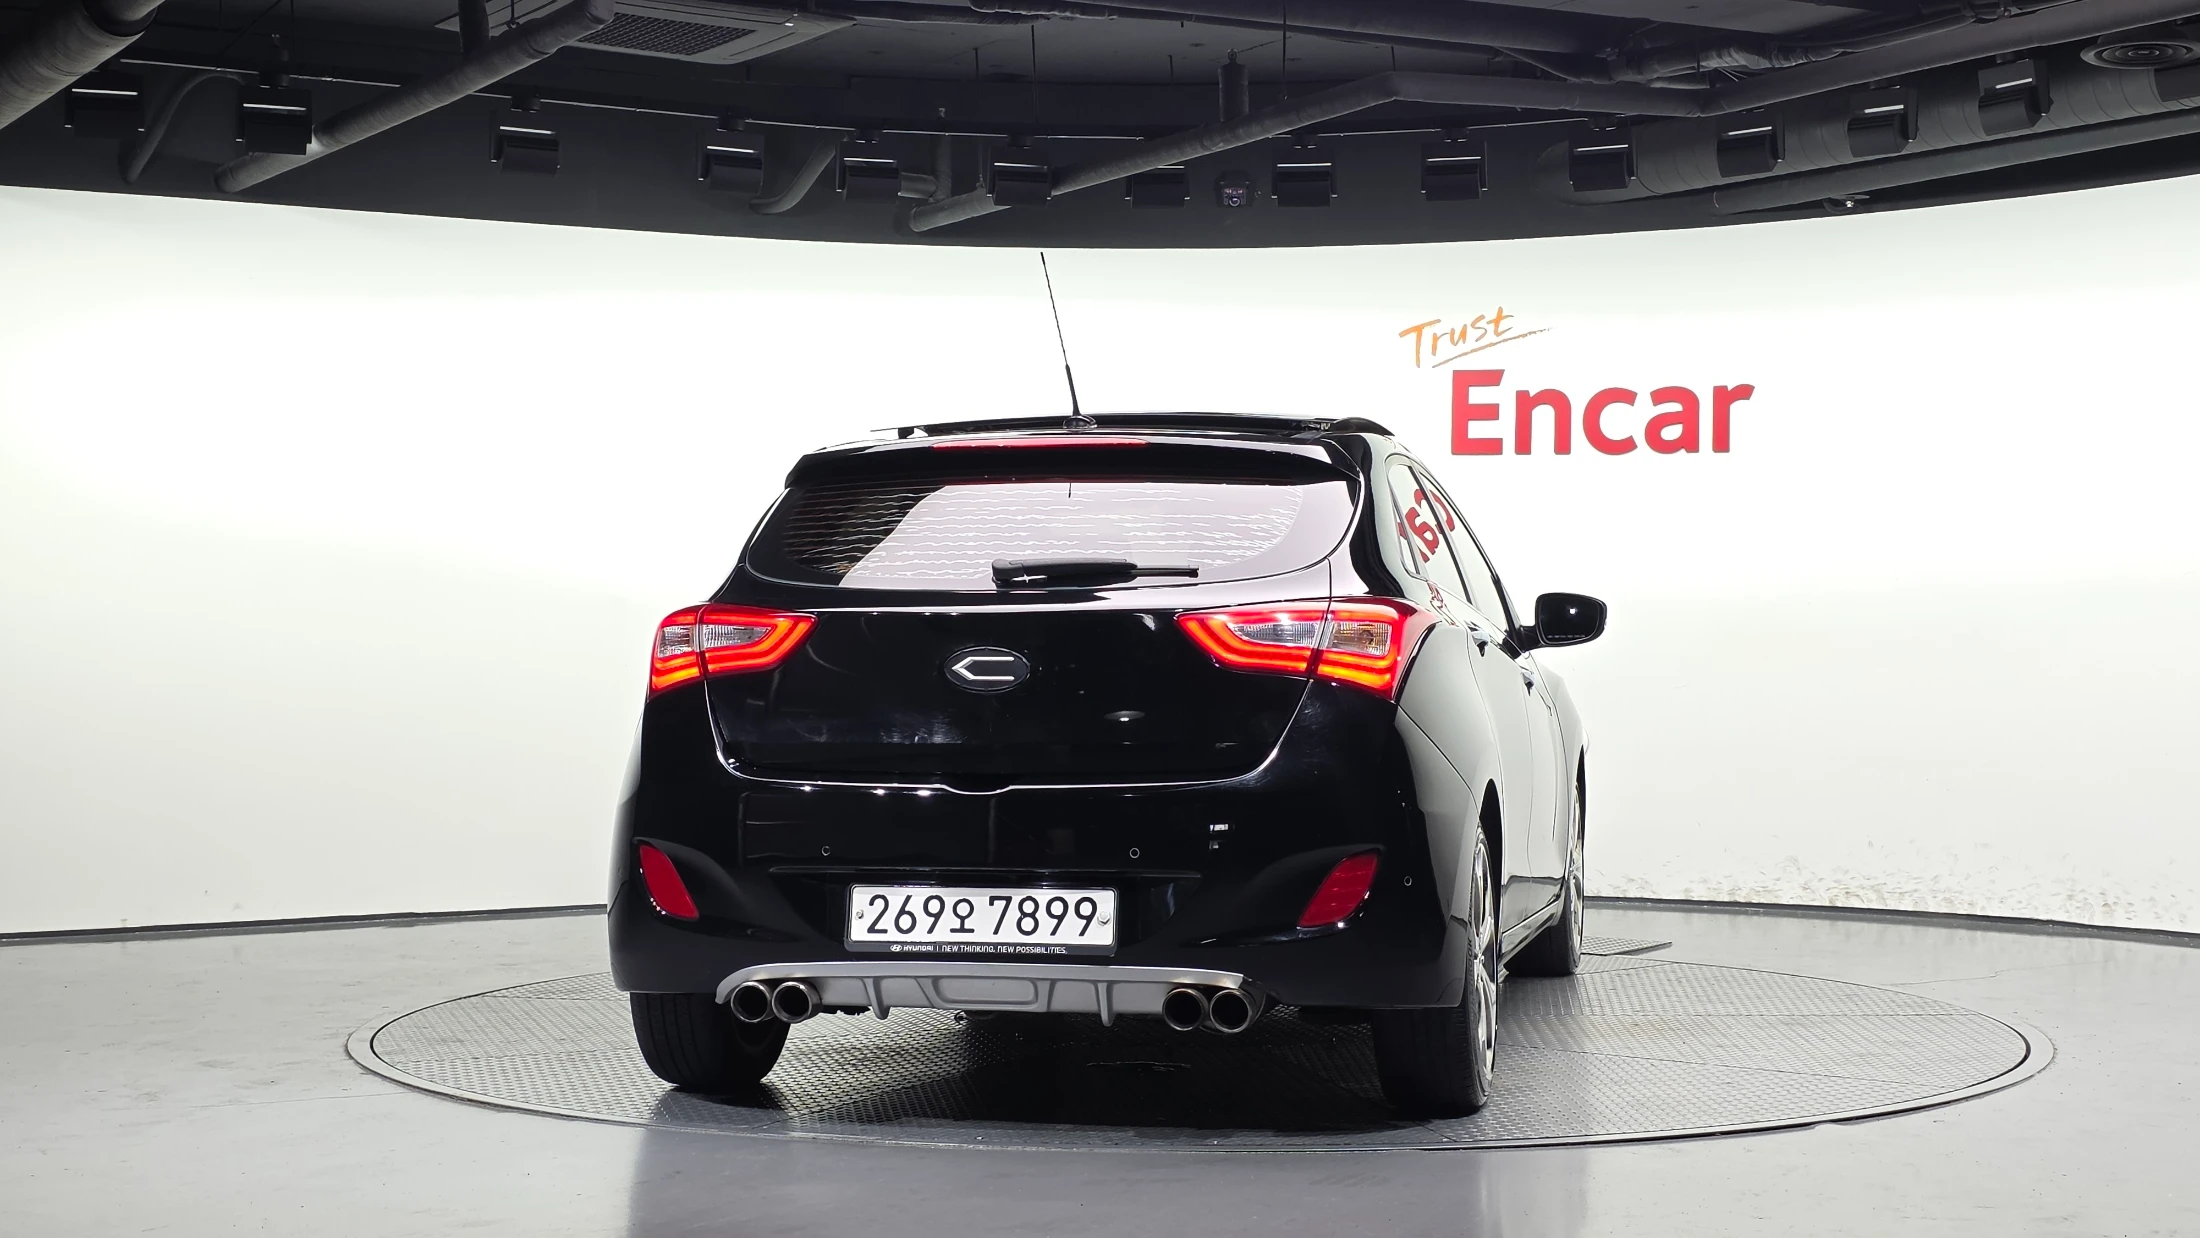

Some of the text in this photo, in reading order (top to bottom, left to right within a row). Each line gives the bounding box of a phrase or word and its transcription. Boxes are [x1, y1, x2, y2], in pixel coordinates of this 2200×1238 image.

[1399, 306, 1515, 368] Trust
[1450, 369, 1756, 456] Encar
[866, 893, 1099, 937] 269오 7899
[997, 945, 1015, 953] NEW
